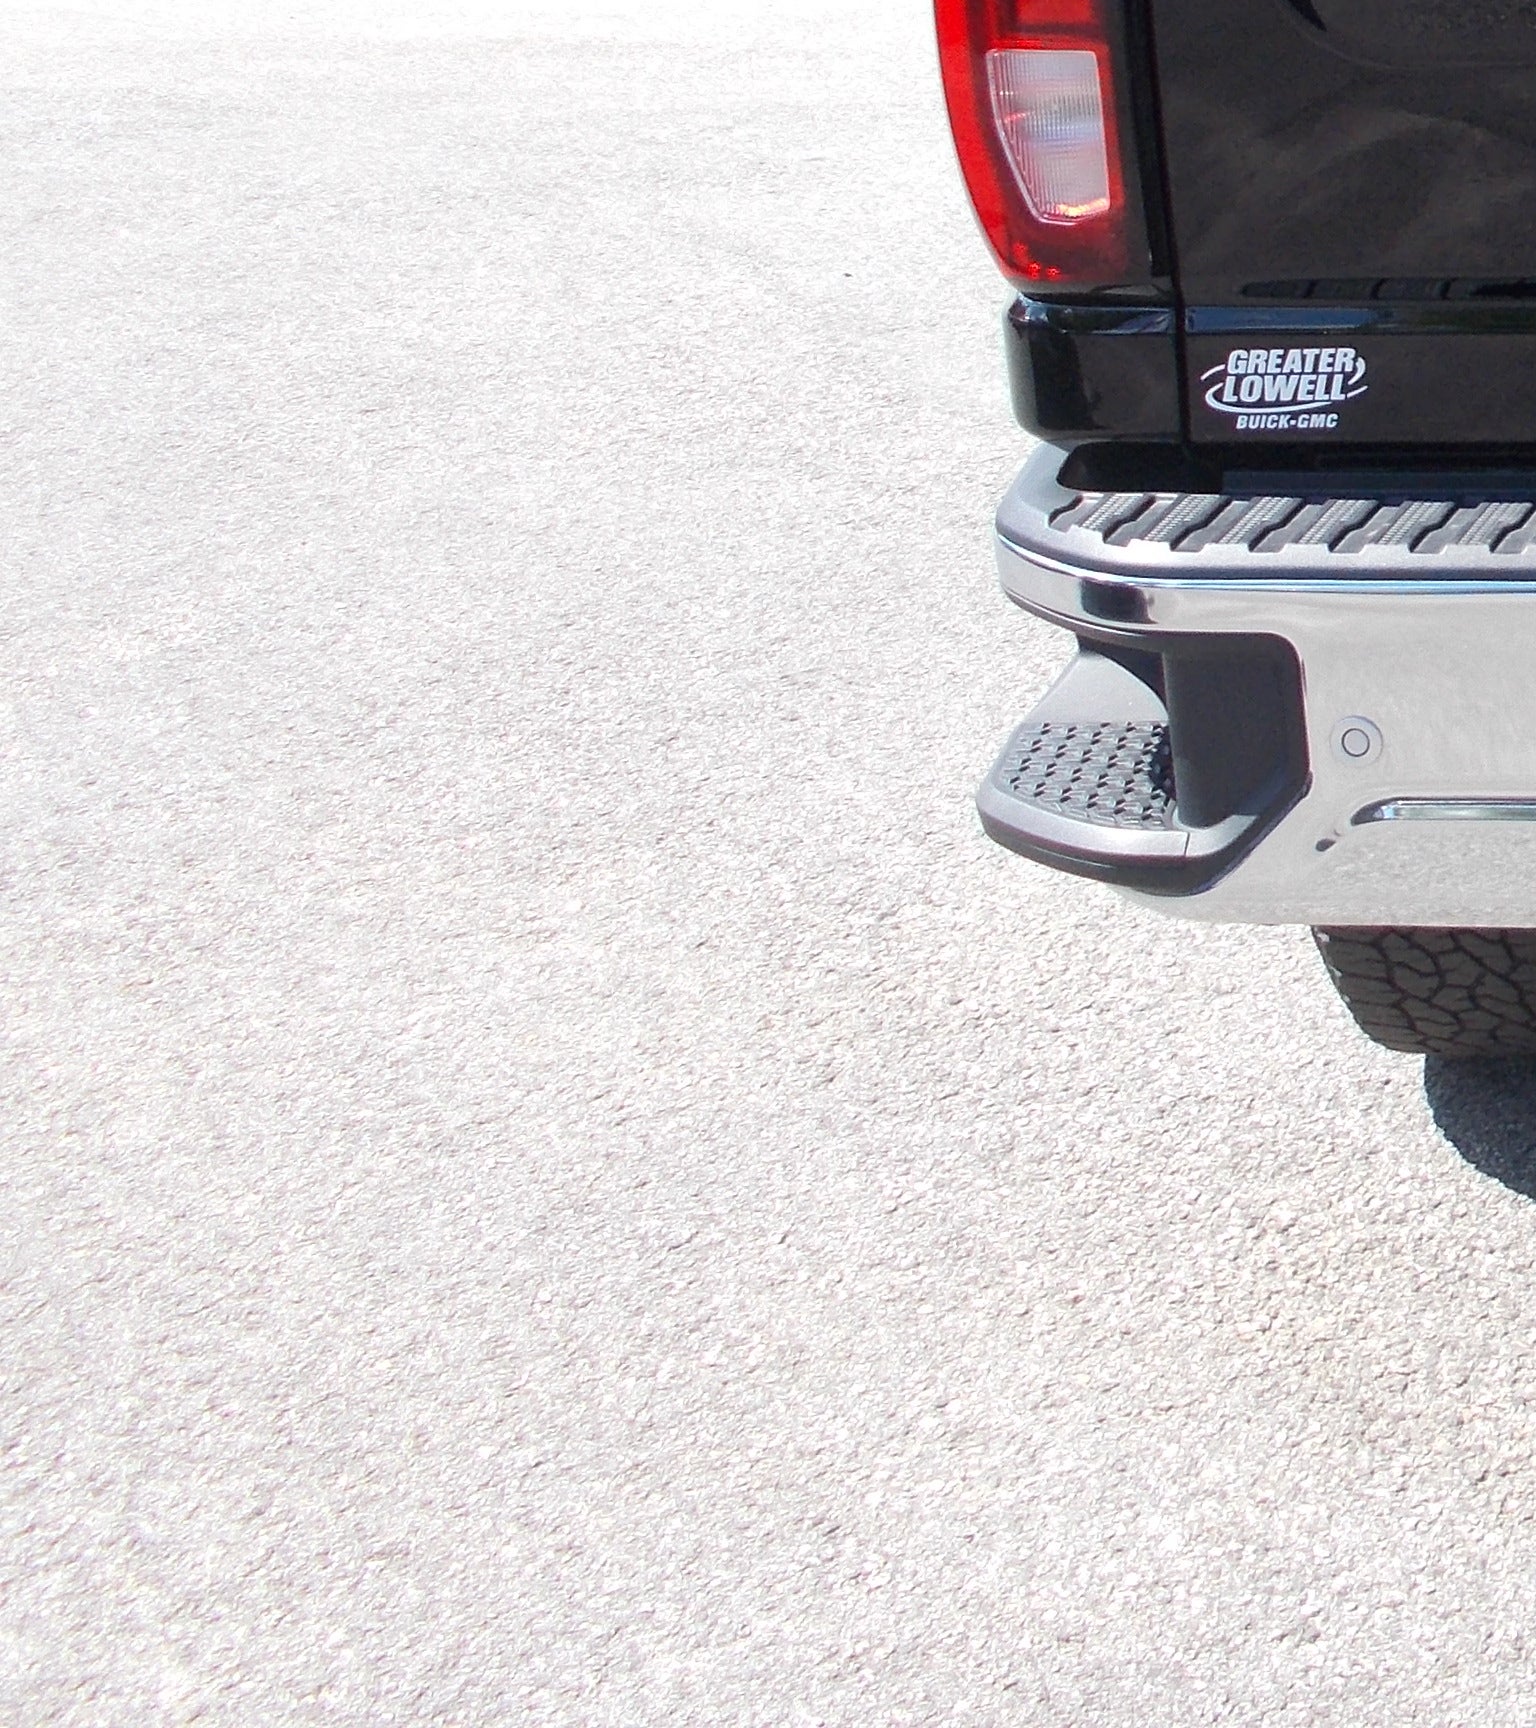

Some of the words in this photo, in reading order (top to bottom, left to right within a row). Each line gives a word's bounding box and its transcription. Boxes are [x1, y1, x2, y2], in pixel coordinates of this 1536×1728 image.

[1227, 348, 1356, 375] GREATER
[1222, 373, 1346, 403] LOWELL
[1236, 413, 1339, 430] BUICK-GMC
